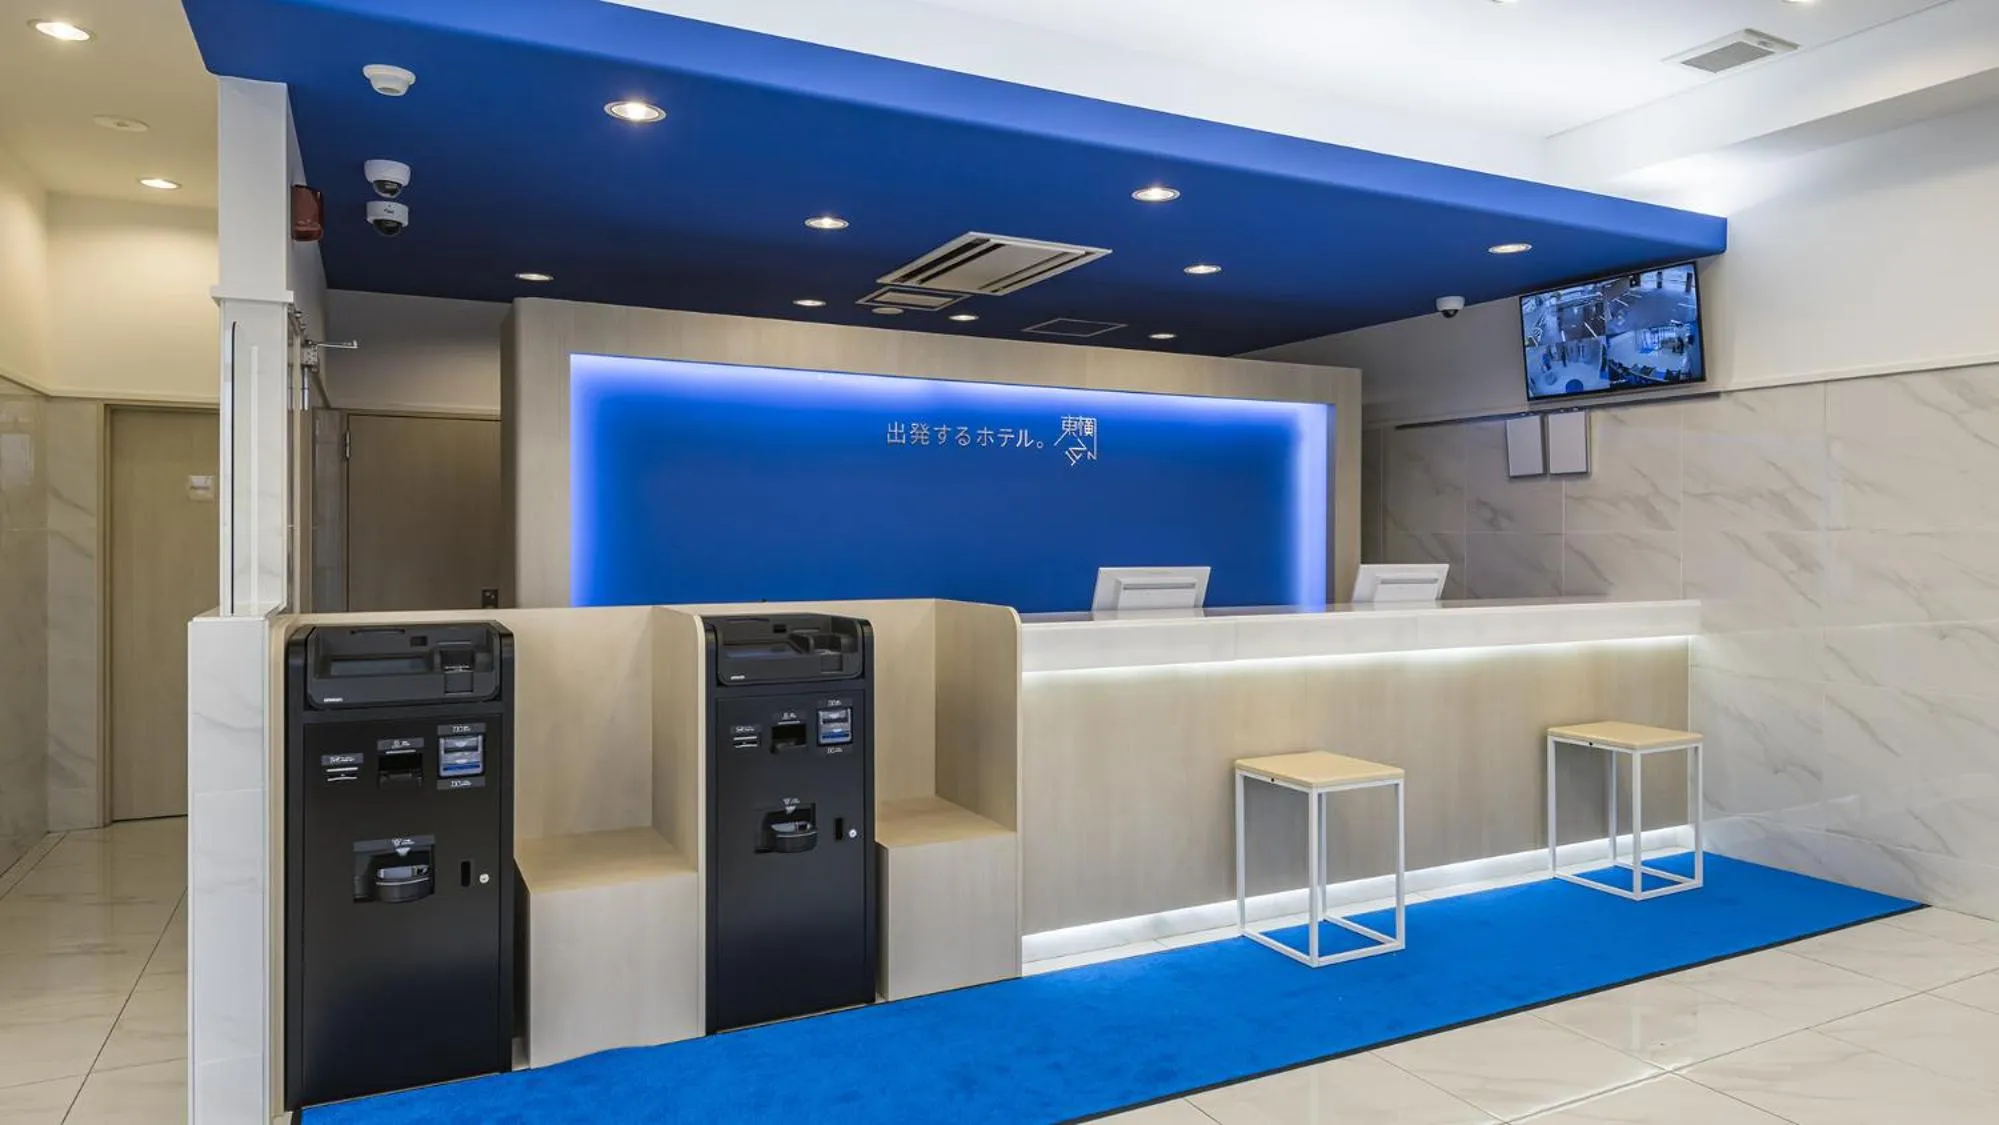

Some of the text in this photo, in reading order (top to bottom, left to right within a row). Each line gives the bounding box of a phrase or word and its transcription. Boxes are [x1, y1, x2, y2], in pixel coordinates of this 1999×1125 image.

[886, 421, 1044, 449] 出発するホテル。
